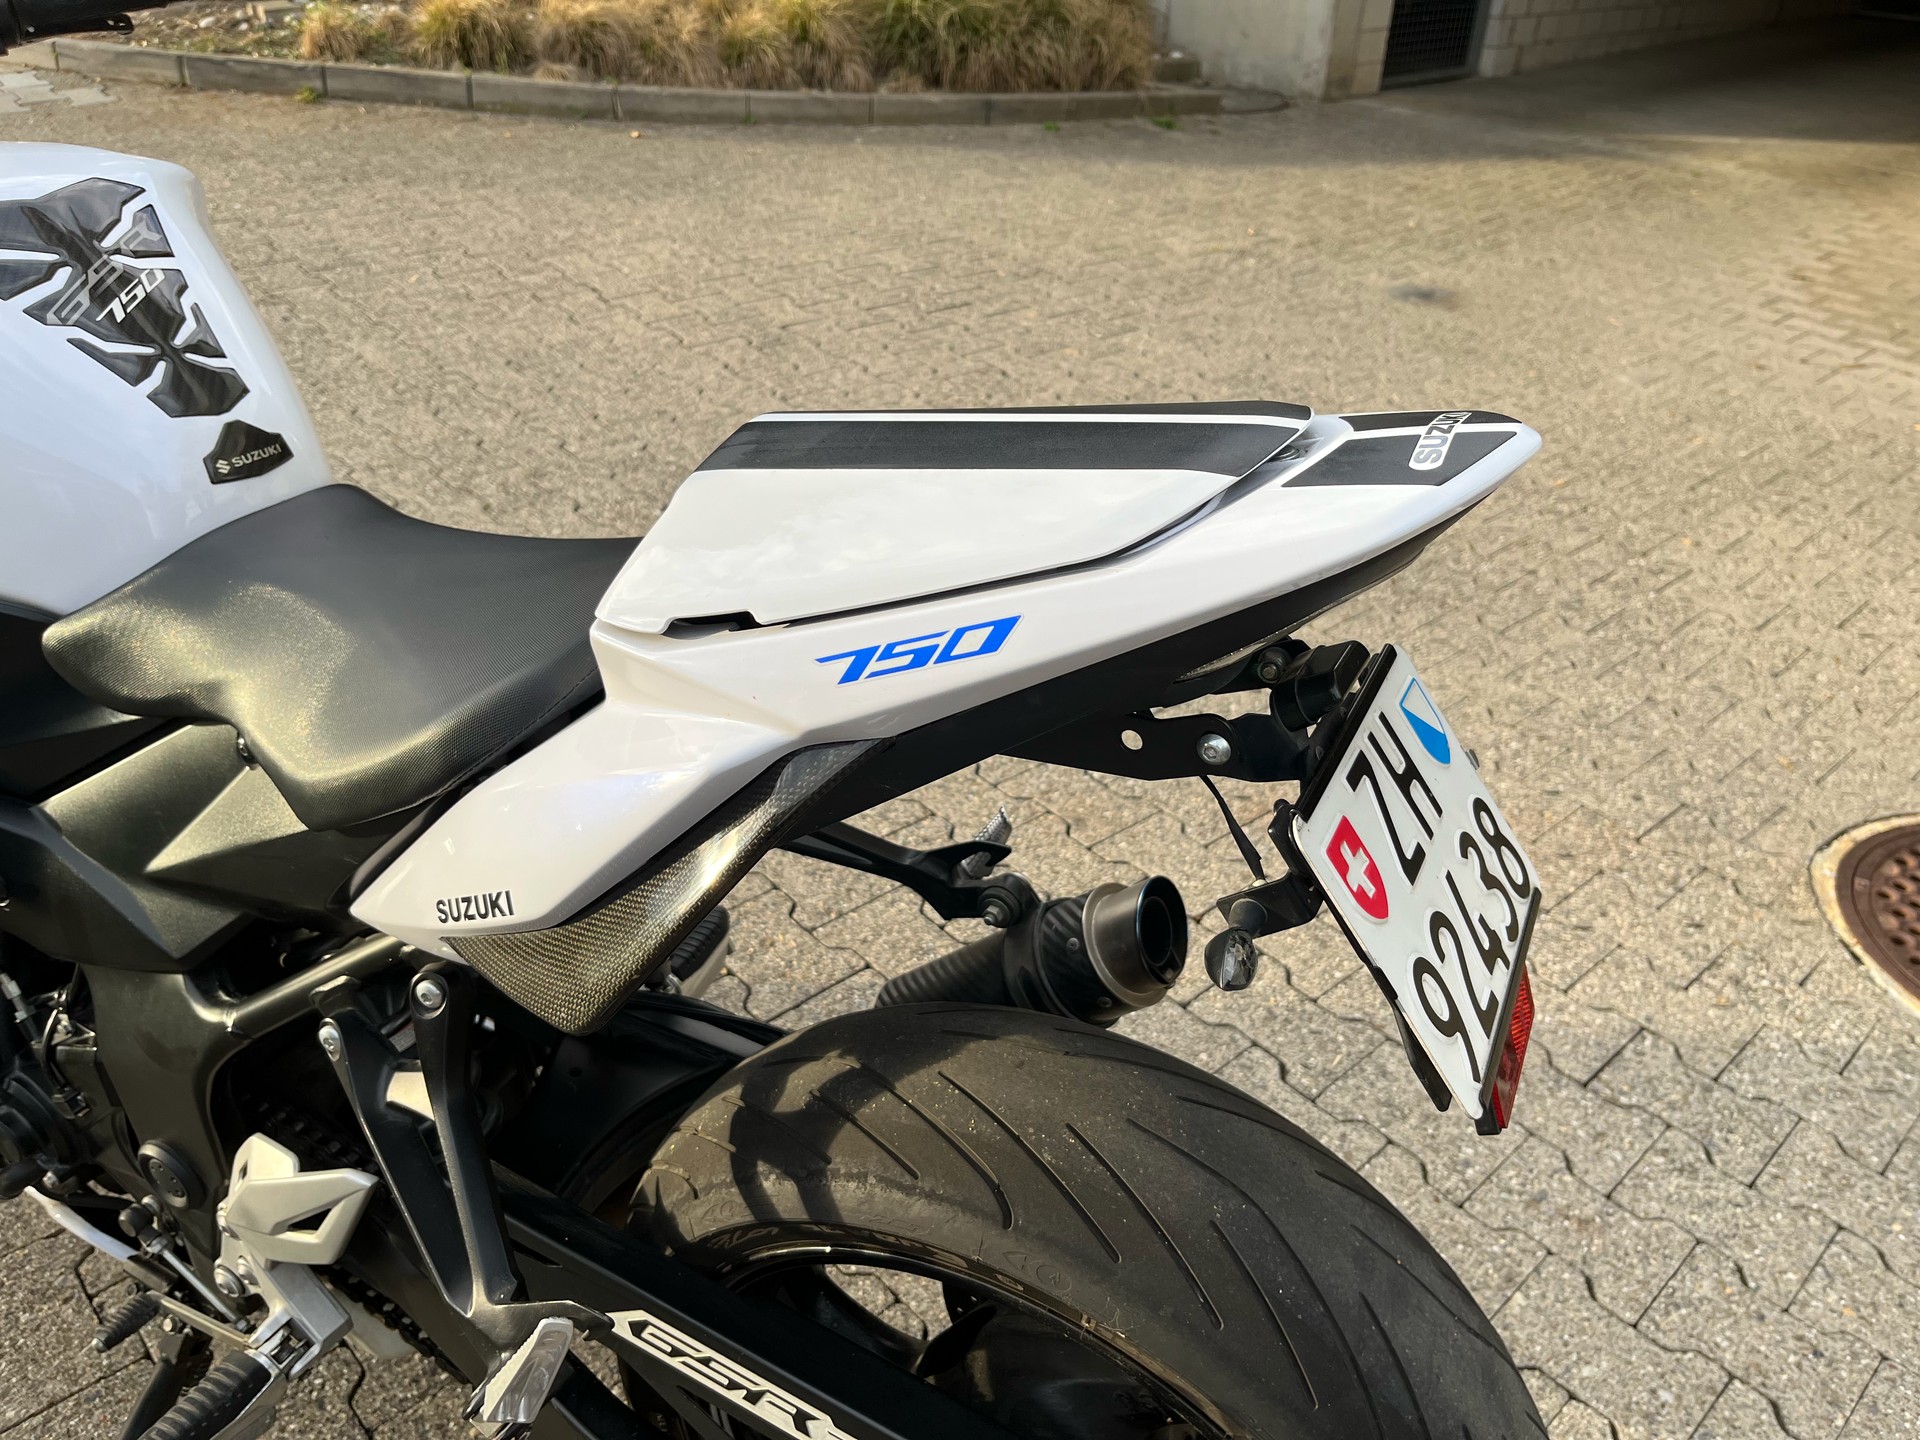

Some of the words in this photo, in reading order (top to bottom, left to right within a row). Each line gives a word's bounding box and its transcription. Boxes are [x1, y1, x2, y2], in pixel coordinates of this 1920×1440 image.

[96, 268, 166, 324] 750
[231, 444, 282, 468] SUZUKI
[1413, 411, 1470, 464] SUZUKI
[813, 614, 1022, 685] 750
[1346, 711, 1443, 886] ZH
[436, 889, 515, 924] SUZUKI
[1412, 797, 1531, 1083] 92438
